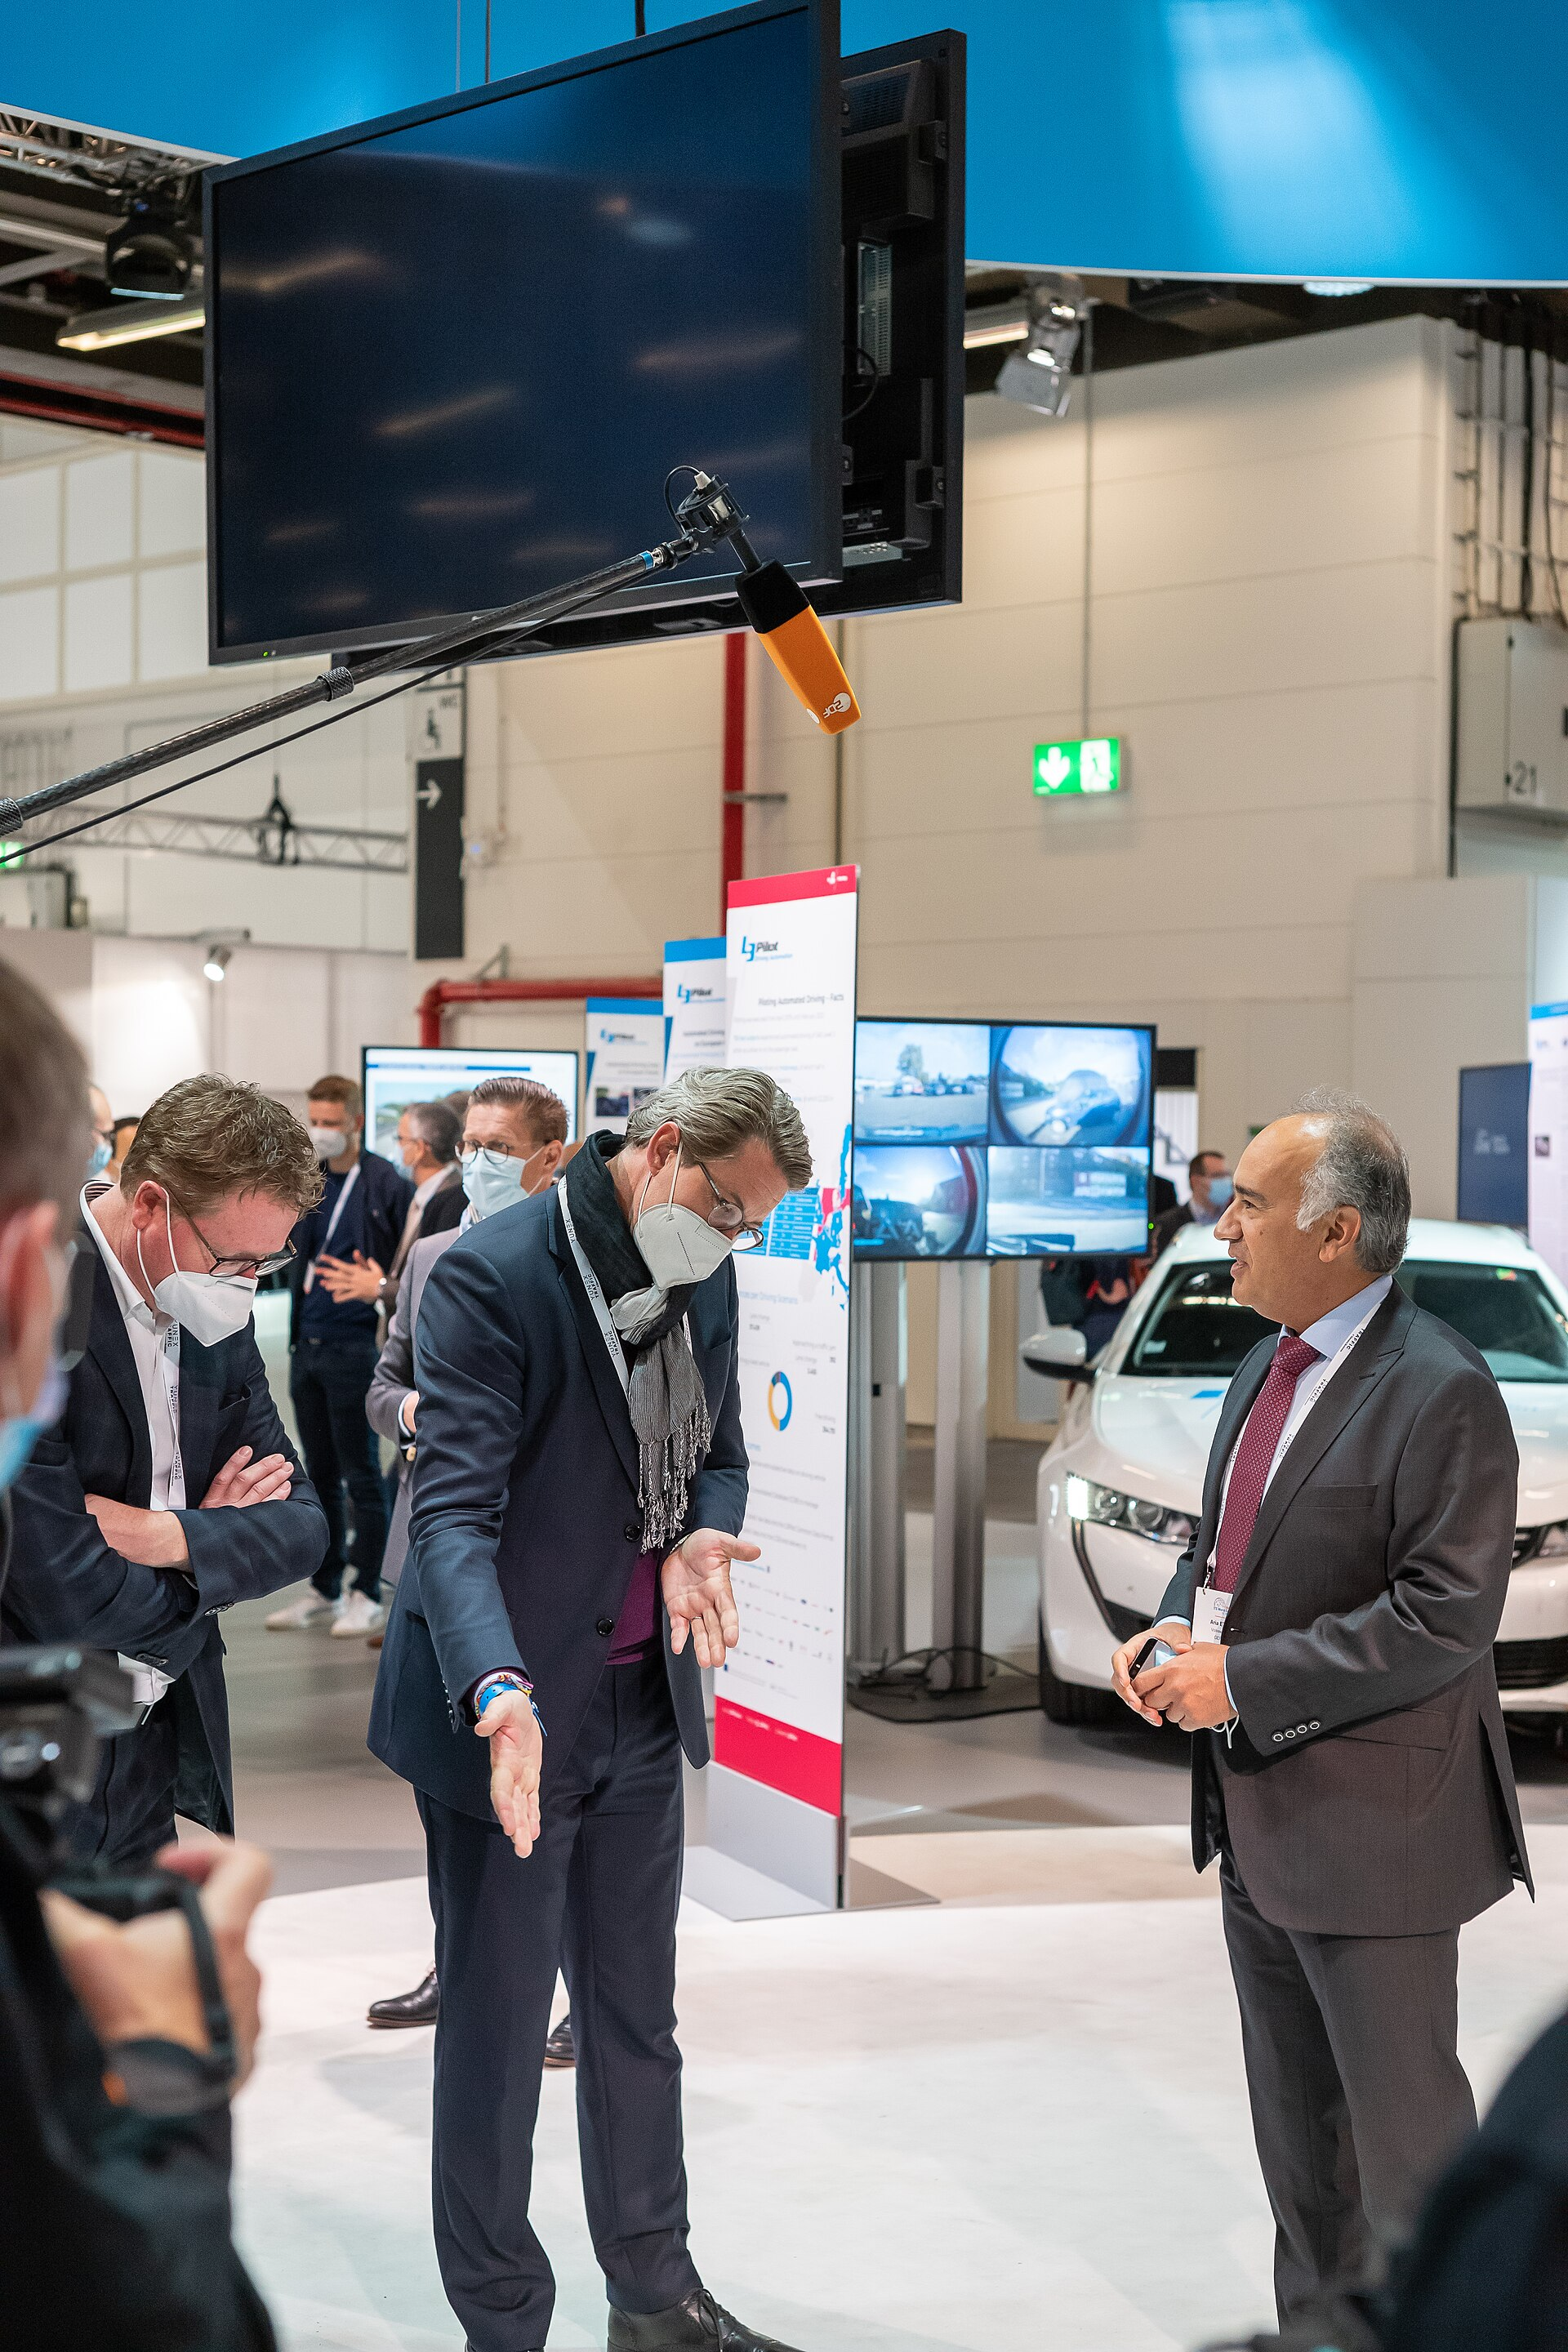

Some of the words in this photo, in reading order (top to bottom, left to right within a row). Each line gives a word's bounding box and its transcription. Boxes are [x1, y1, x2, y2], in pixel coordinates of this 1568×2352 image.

[565, 1218, 576, 1244] YUNEX
[583, 1275, 595, 1301] YUNEX
[588, 1274, 599, 1298] TRAFFIC
[604, 1332, 616, 1357] YUNEX
